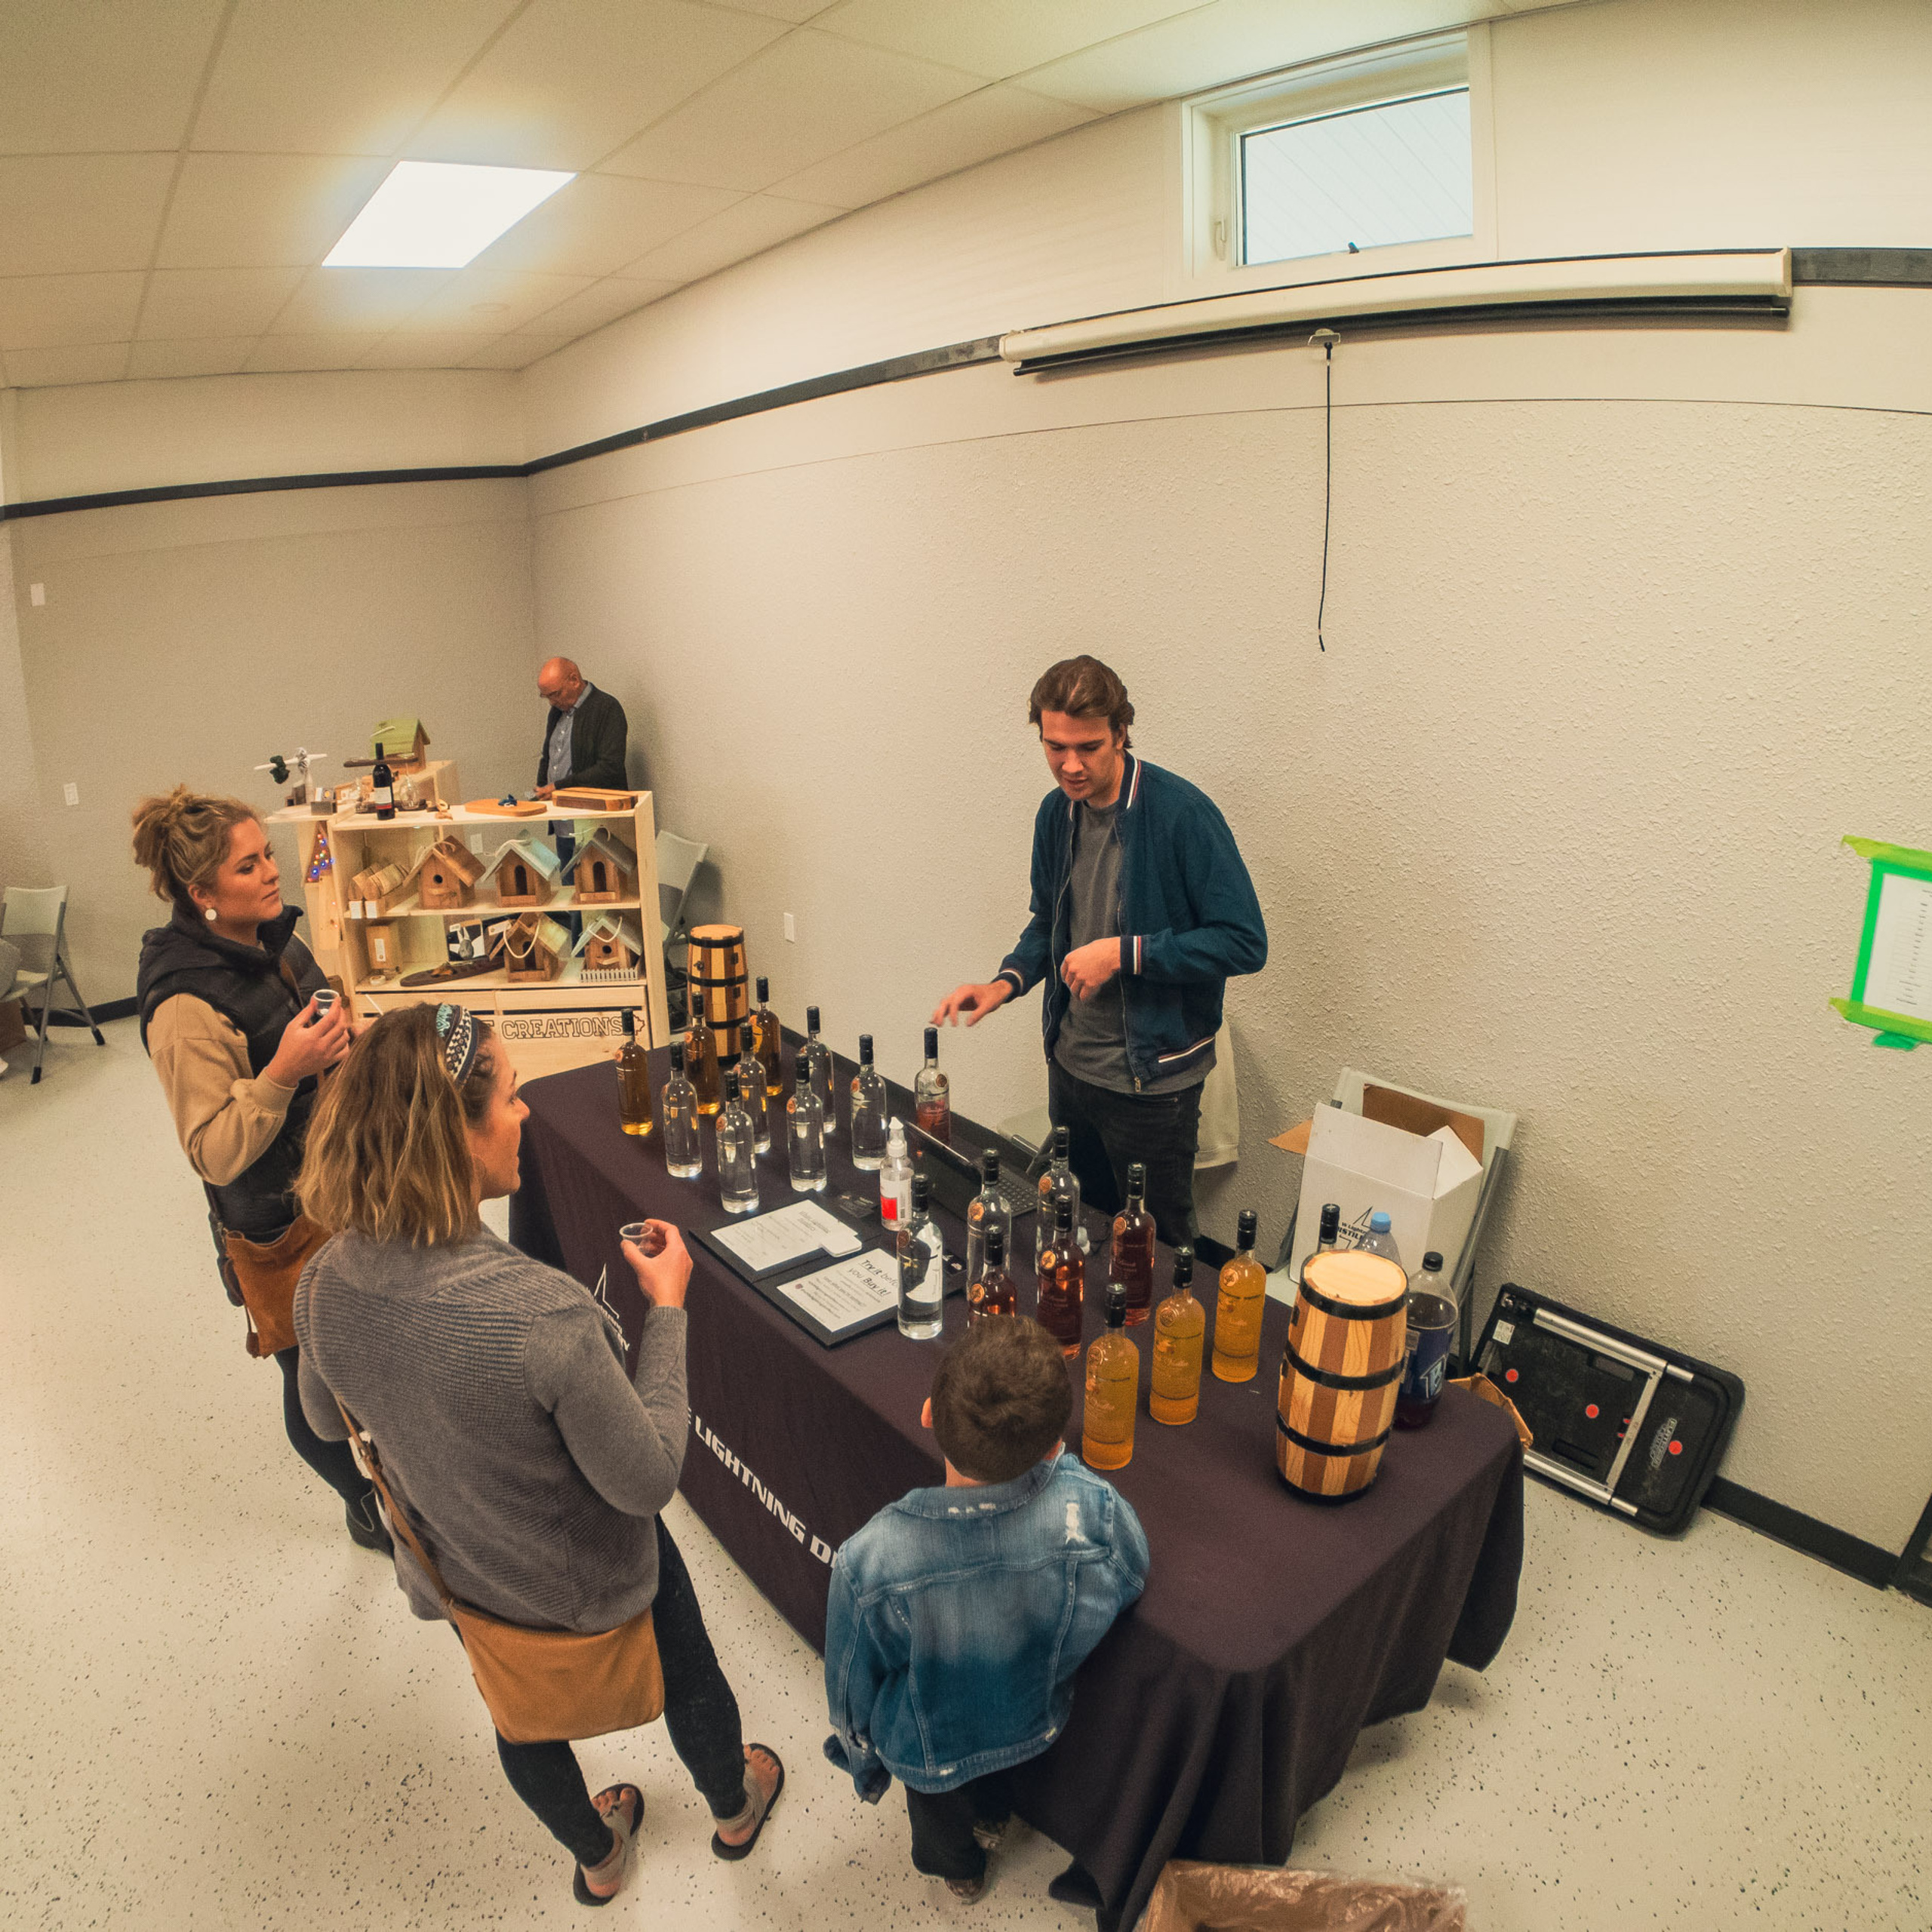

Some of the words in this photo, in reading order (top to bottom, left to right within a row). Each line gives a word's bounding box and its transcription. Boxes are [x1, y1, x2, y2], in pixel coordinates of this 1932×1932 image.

[501, 1016, 623, 1039] CREATIONS
[861, 1260, 875, 1270] Try
[847, 1268, 864, 1278] you
[863, 1277, 880, 1289] Buy
[694, 1414, 807, 1545] LIGHTNING
